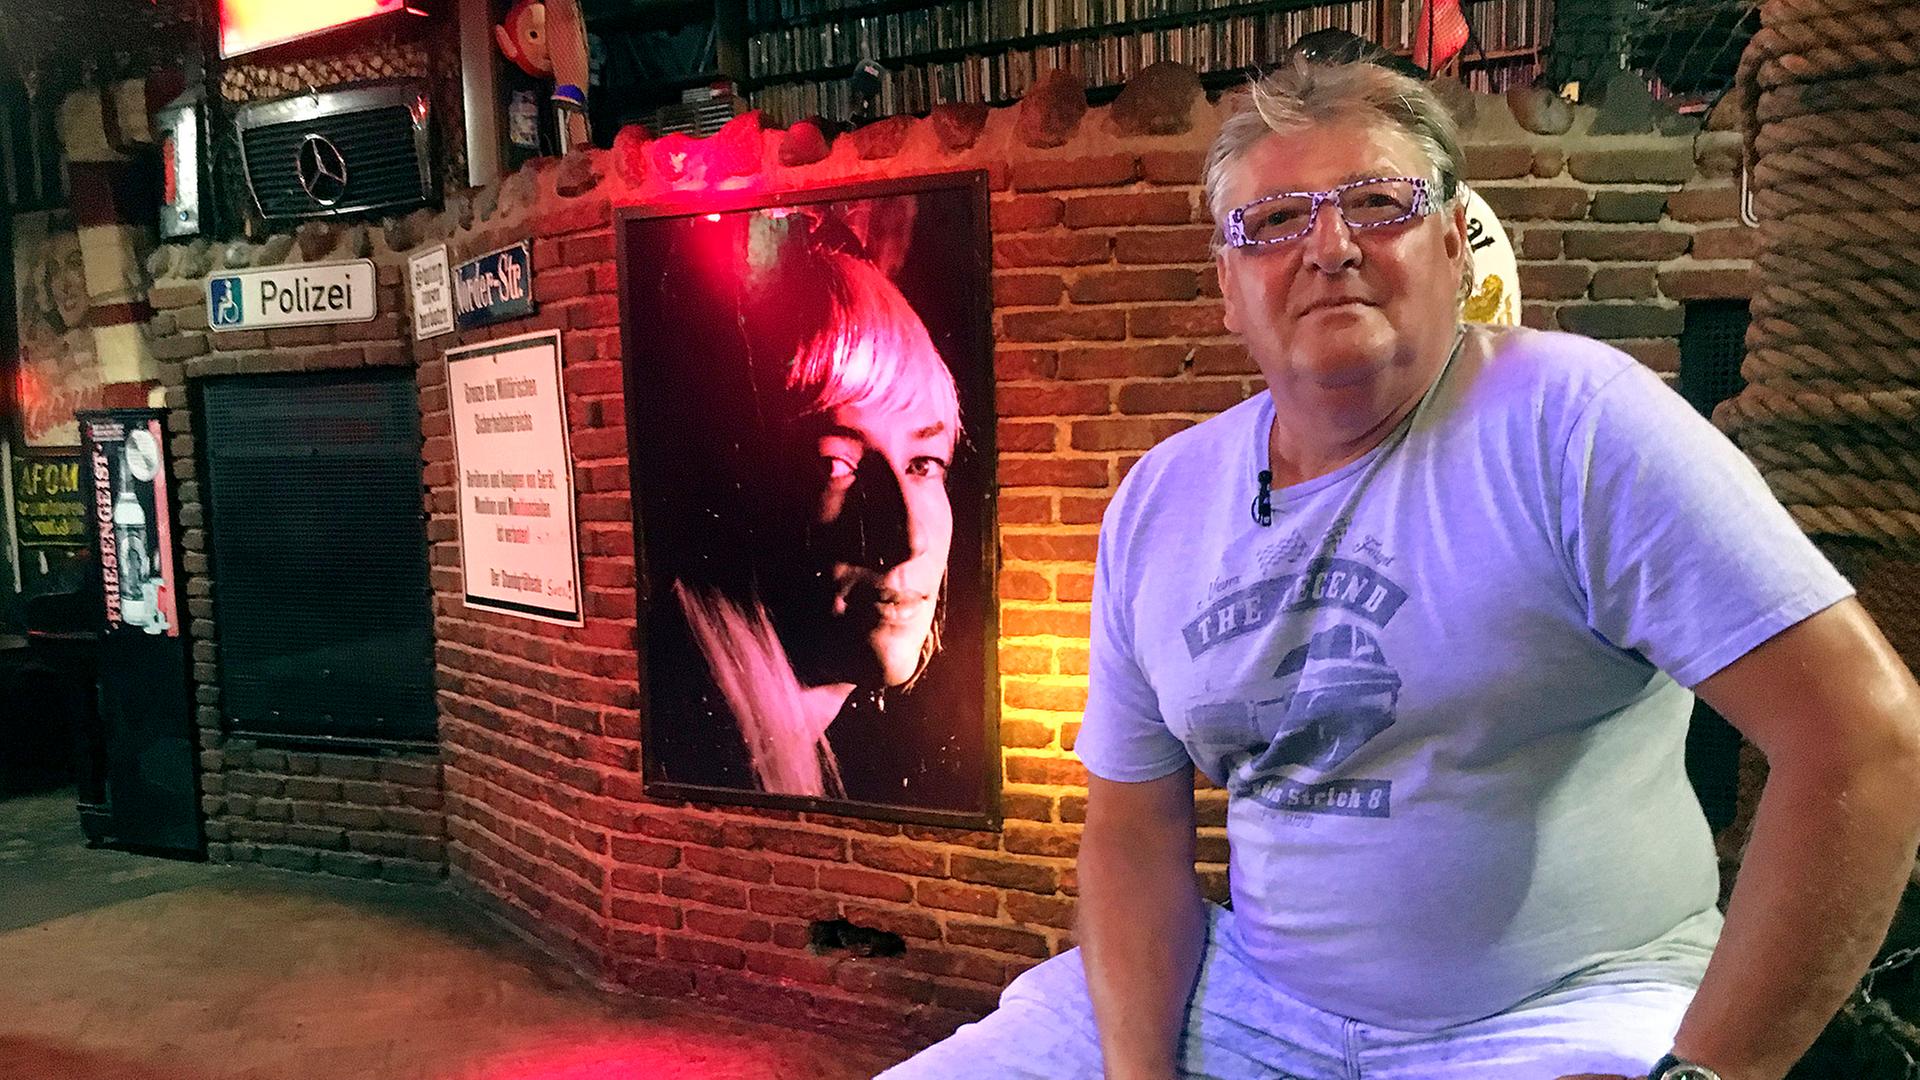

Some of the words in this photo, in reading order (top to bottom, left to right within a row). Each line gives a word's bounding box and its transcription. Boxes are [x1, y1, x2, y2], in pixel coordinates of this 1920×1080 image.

[1466, 217, 1496, 254] at
[260, 273, 352, 316] Polizei
[92, 450, 122, 624] FRIESENGEIST
[1198, 600, 1262, 645] THE
[1291, 571, 1389, 613] EGEND
[1367, 788, 1383, 809] 8
